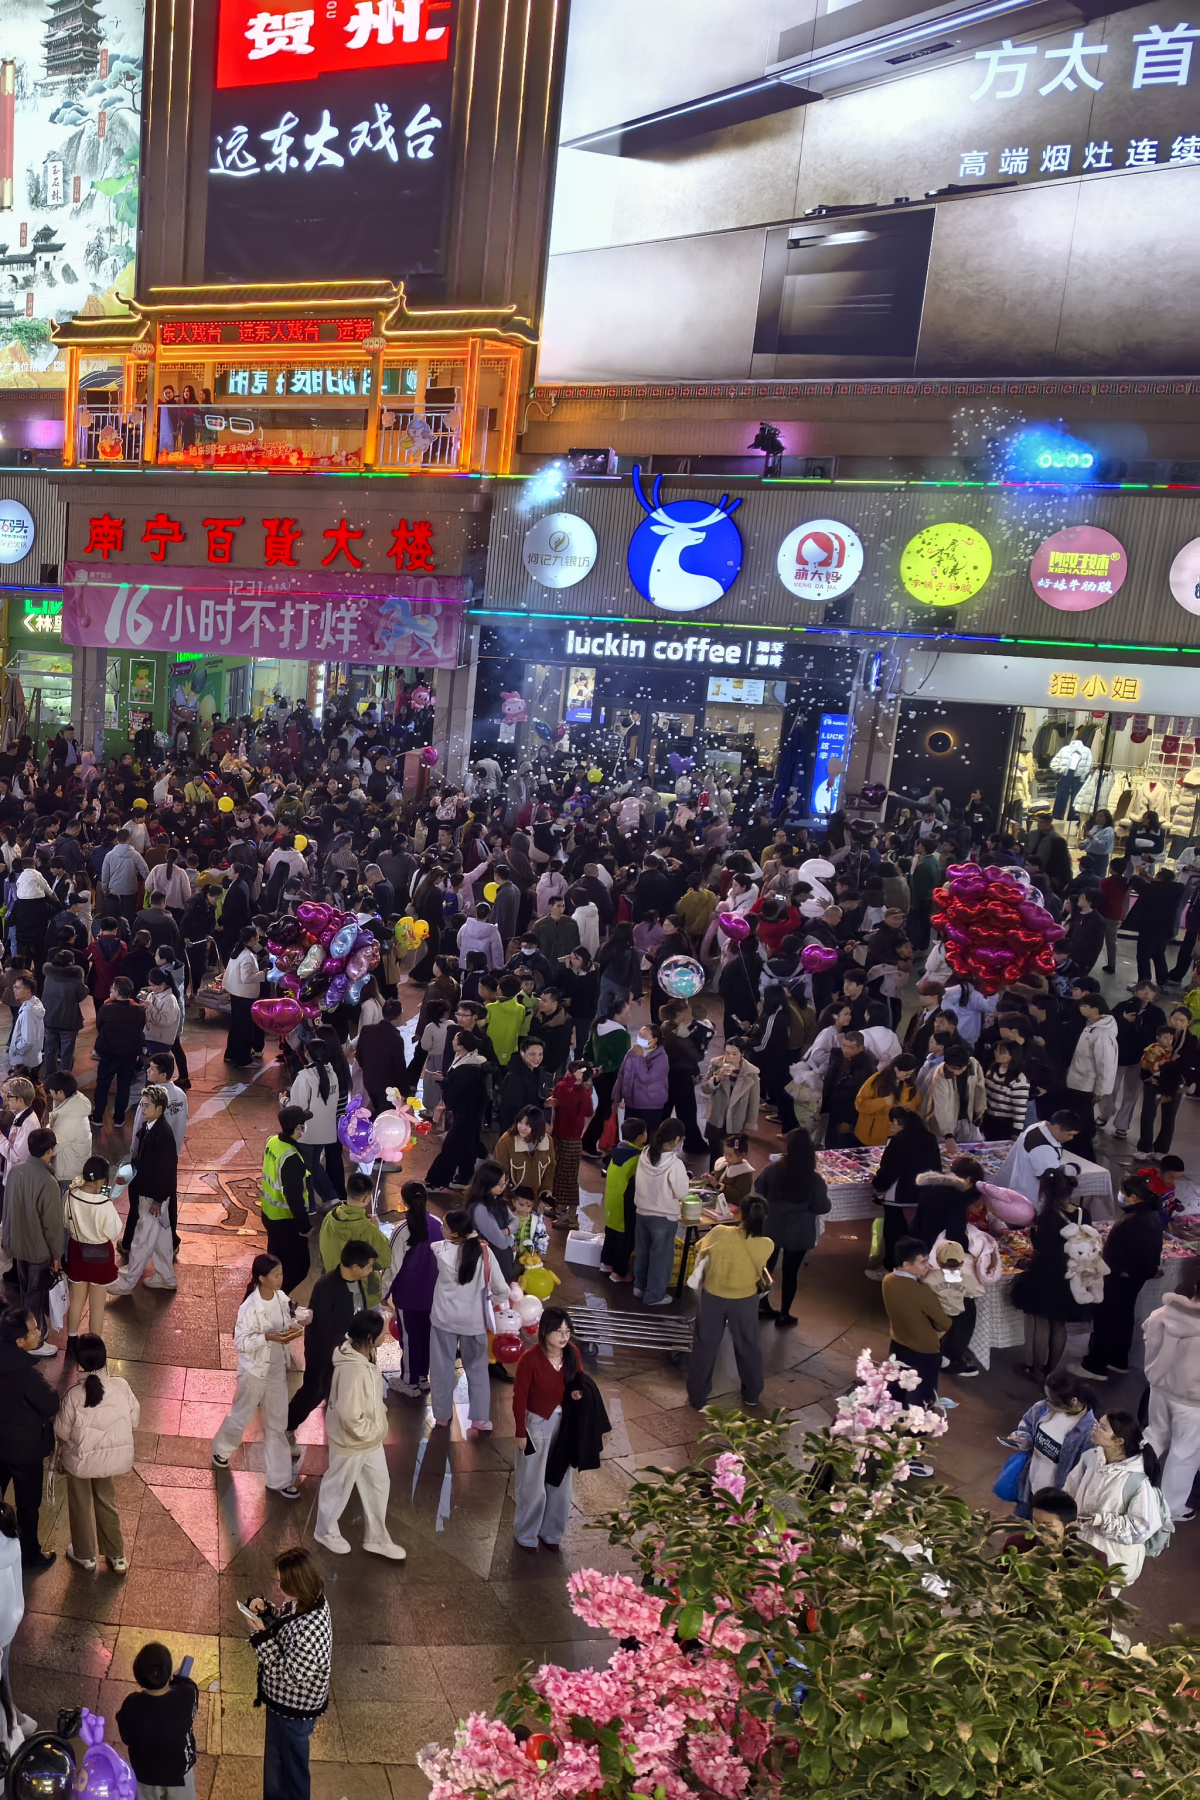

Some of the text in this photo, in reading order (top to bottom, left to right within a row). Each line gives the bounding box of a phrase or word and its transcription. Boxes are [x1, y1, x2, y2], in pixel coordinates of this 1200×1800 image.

[969, 32, 1109, 102] 方太
[208, 102, 443, 177] 远东大戏台
[958, 135, 1200, 178] 高端烟灶连续
[528, 552, 591, 567] 何记九银坊
[794, 567, 841, 583] 萌大妈
[1048, 567, 1109, 577] XIEHAOMEI
[1037, 577, 1114, 595] 好妹牛肠酸
[104, 584, 360, 653] 16小时不打烊
[566, 630, 742, 665] luckin coffee
[1050, 673, 1139, 701] 猫小姐
